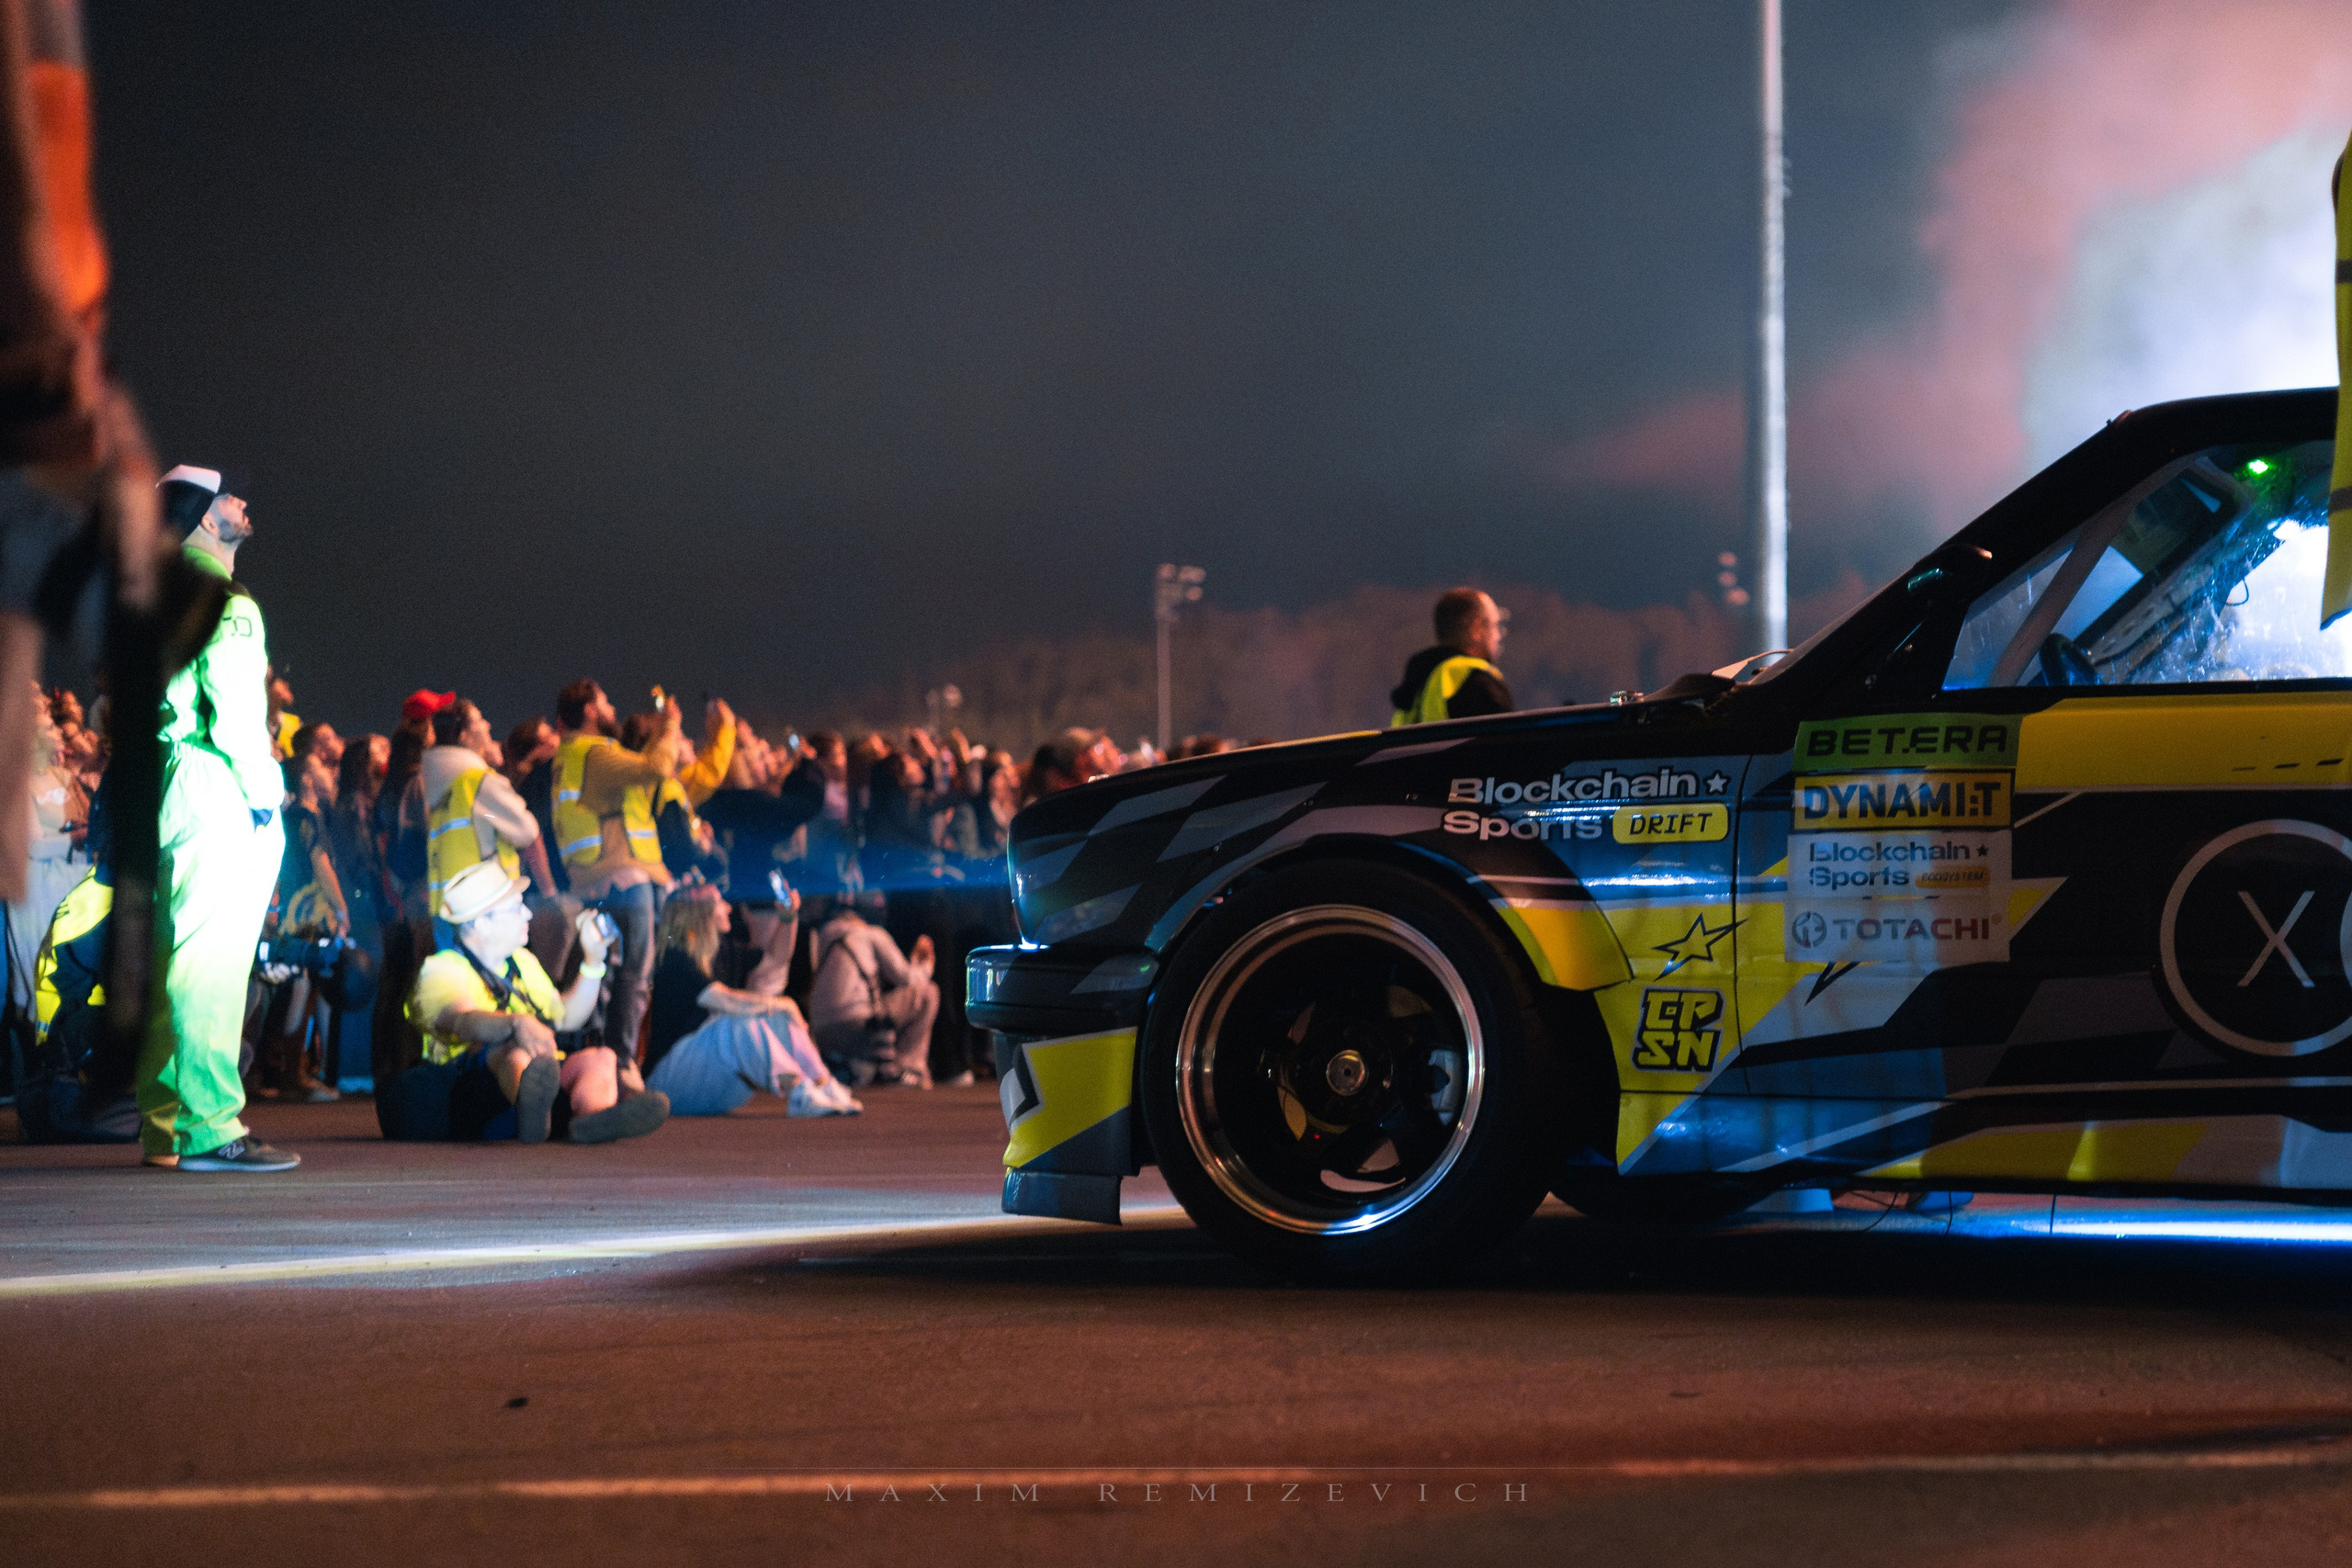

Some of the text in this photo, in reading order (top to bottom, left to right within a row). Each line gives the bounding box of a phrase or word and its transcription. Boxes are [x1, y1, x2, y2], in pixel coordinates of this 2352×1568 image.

[1447, 768, 1697, 805] Blockchain
[1443, 808, 1713, 840] Sports DRIFT
[1809, 840, 1971, 863] Blockchain
[1809, 865, 1910, 890] Sports
[1832, 918, 1990, 941] TOTACHI
[2236, 889, 2316, 988] X
